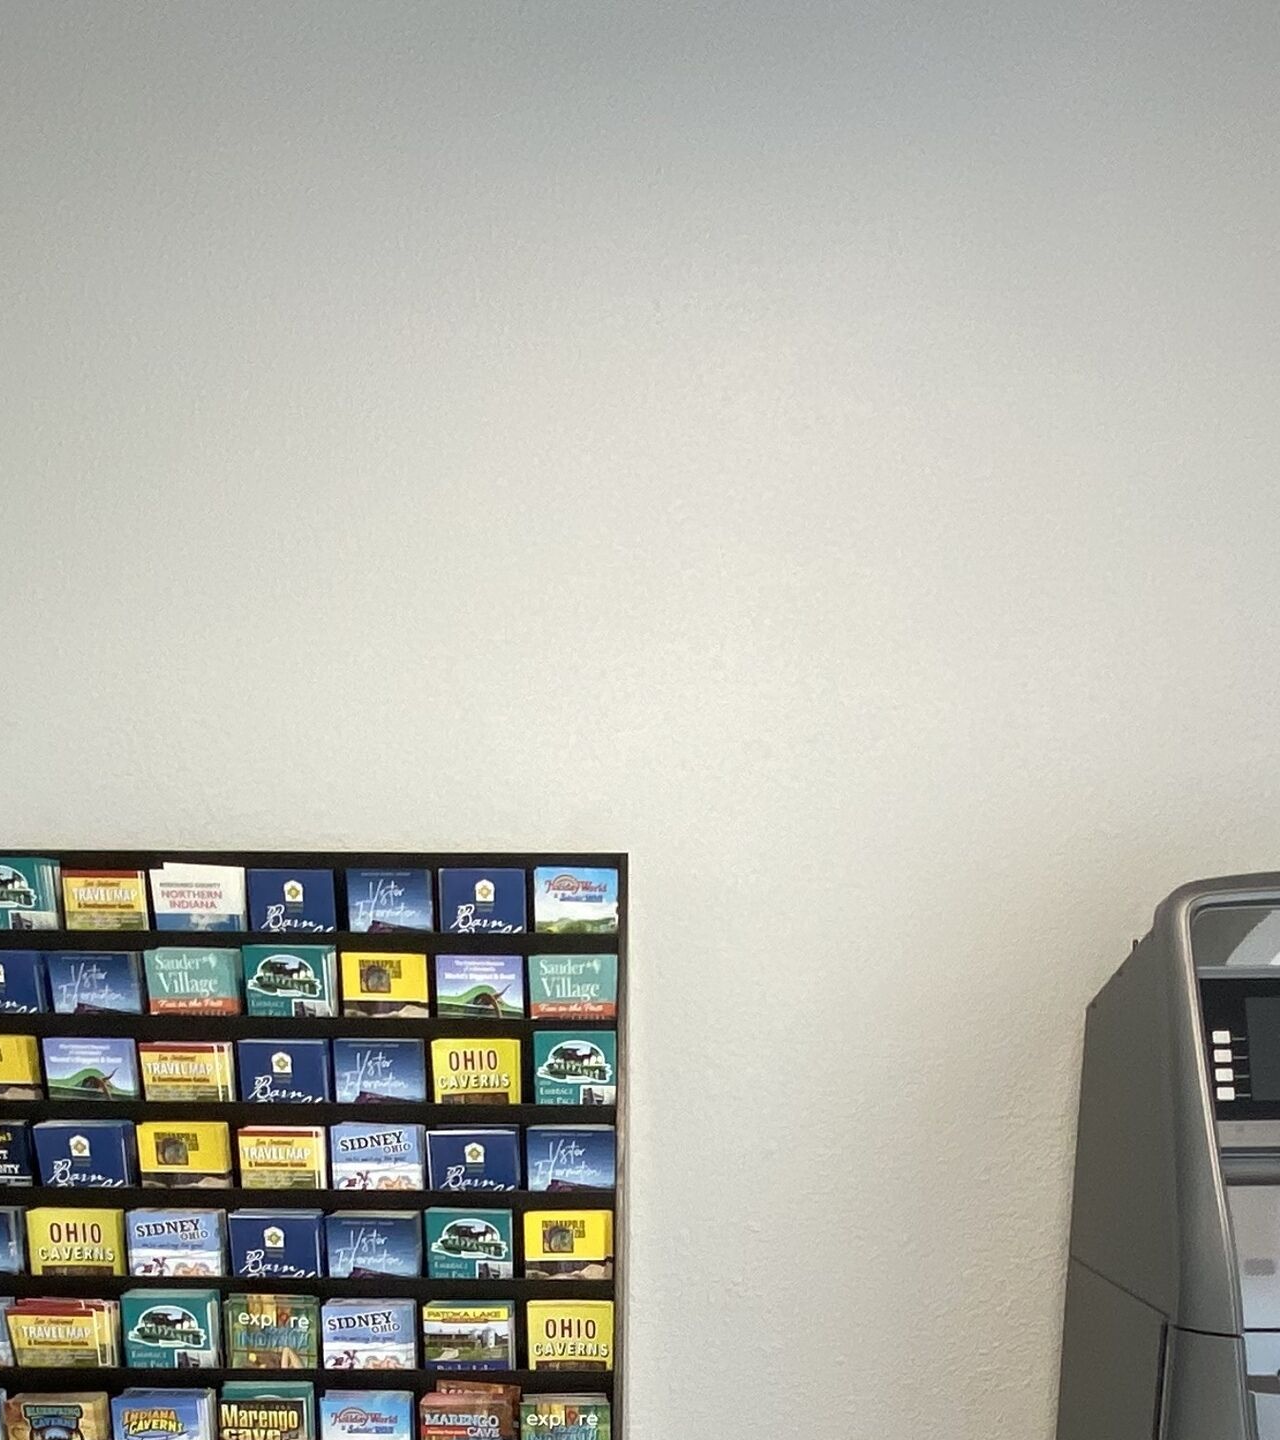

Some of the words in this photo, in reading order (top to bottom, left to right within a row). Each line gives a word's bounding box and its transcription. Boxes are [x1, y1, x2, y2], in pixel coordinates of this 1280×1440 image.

[73, 888, 110, 902] TRAVEL
[111, 887, 137, 902] MAP
[161, 890, 222, 899] NORTHERN
[581, 883, 607, 892] World
[170, 900, 217, 908] INDIANA
[261, 904, 317, 929] Barn
[451, 904, 504, 929] Barn
[155, 953, 201, 970] Sauder
[540, 959, 584, 976] Sauder
[159, 972, 218, 996] Village
[541, 977, 600, 1001] Village
[146, 1062, 186, 1074] TRAVEL
[191, 1062, 214, 1075] MAP
[449, 1050, 497, 1071] OHIO
[249, 1075, 304, 1099] Barn
[438, 1073, 511, 1089] CAVERNS
[339, 1131, 403, 1152] SIDNEY
[383, 1143, 411, 1154] OHIO
[242, 1147, 285, 1160] TRAVEL
[285, 1148, 312, 1160] MAP
[49, 1159, 107, 1183] Barn
[440, 1165, 499, 1188] Barn
[49, 1222, 102, 1243] OHIO
[136, 1219, 200, 1238] SIDNEY
[180, 1230, 208, 1241] OHIO
[38, 1246, 115, 1261] CAVERNS
[239, 1249, 297, 1274] Barn
[327, 1310, 392, 1331] SIDNEY
[371, 1323, 400, 1334] OHIO
[22, 1325, 66, 1338] TRAVEL
[67, 1326, 92, 1337] MAP
[545, 1319, 596, 1339] OHIO
[533, 1342, 610, 1357] CAVERNS
[124, 1410, 177, 1422] INDIANA
[221, 1404, 298, 1432] Marengo
[331, 1412, 368, 1427] Holiday
[368, 1413, 398, 1423] World
[424, 1413, 499, 1426] MARENGO
[129, 1419, 184, 1433] CAVERNS
[467, 1427, 500, 1437] CAVE
